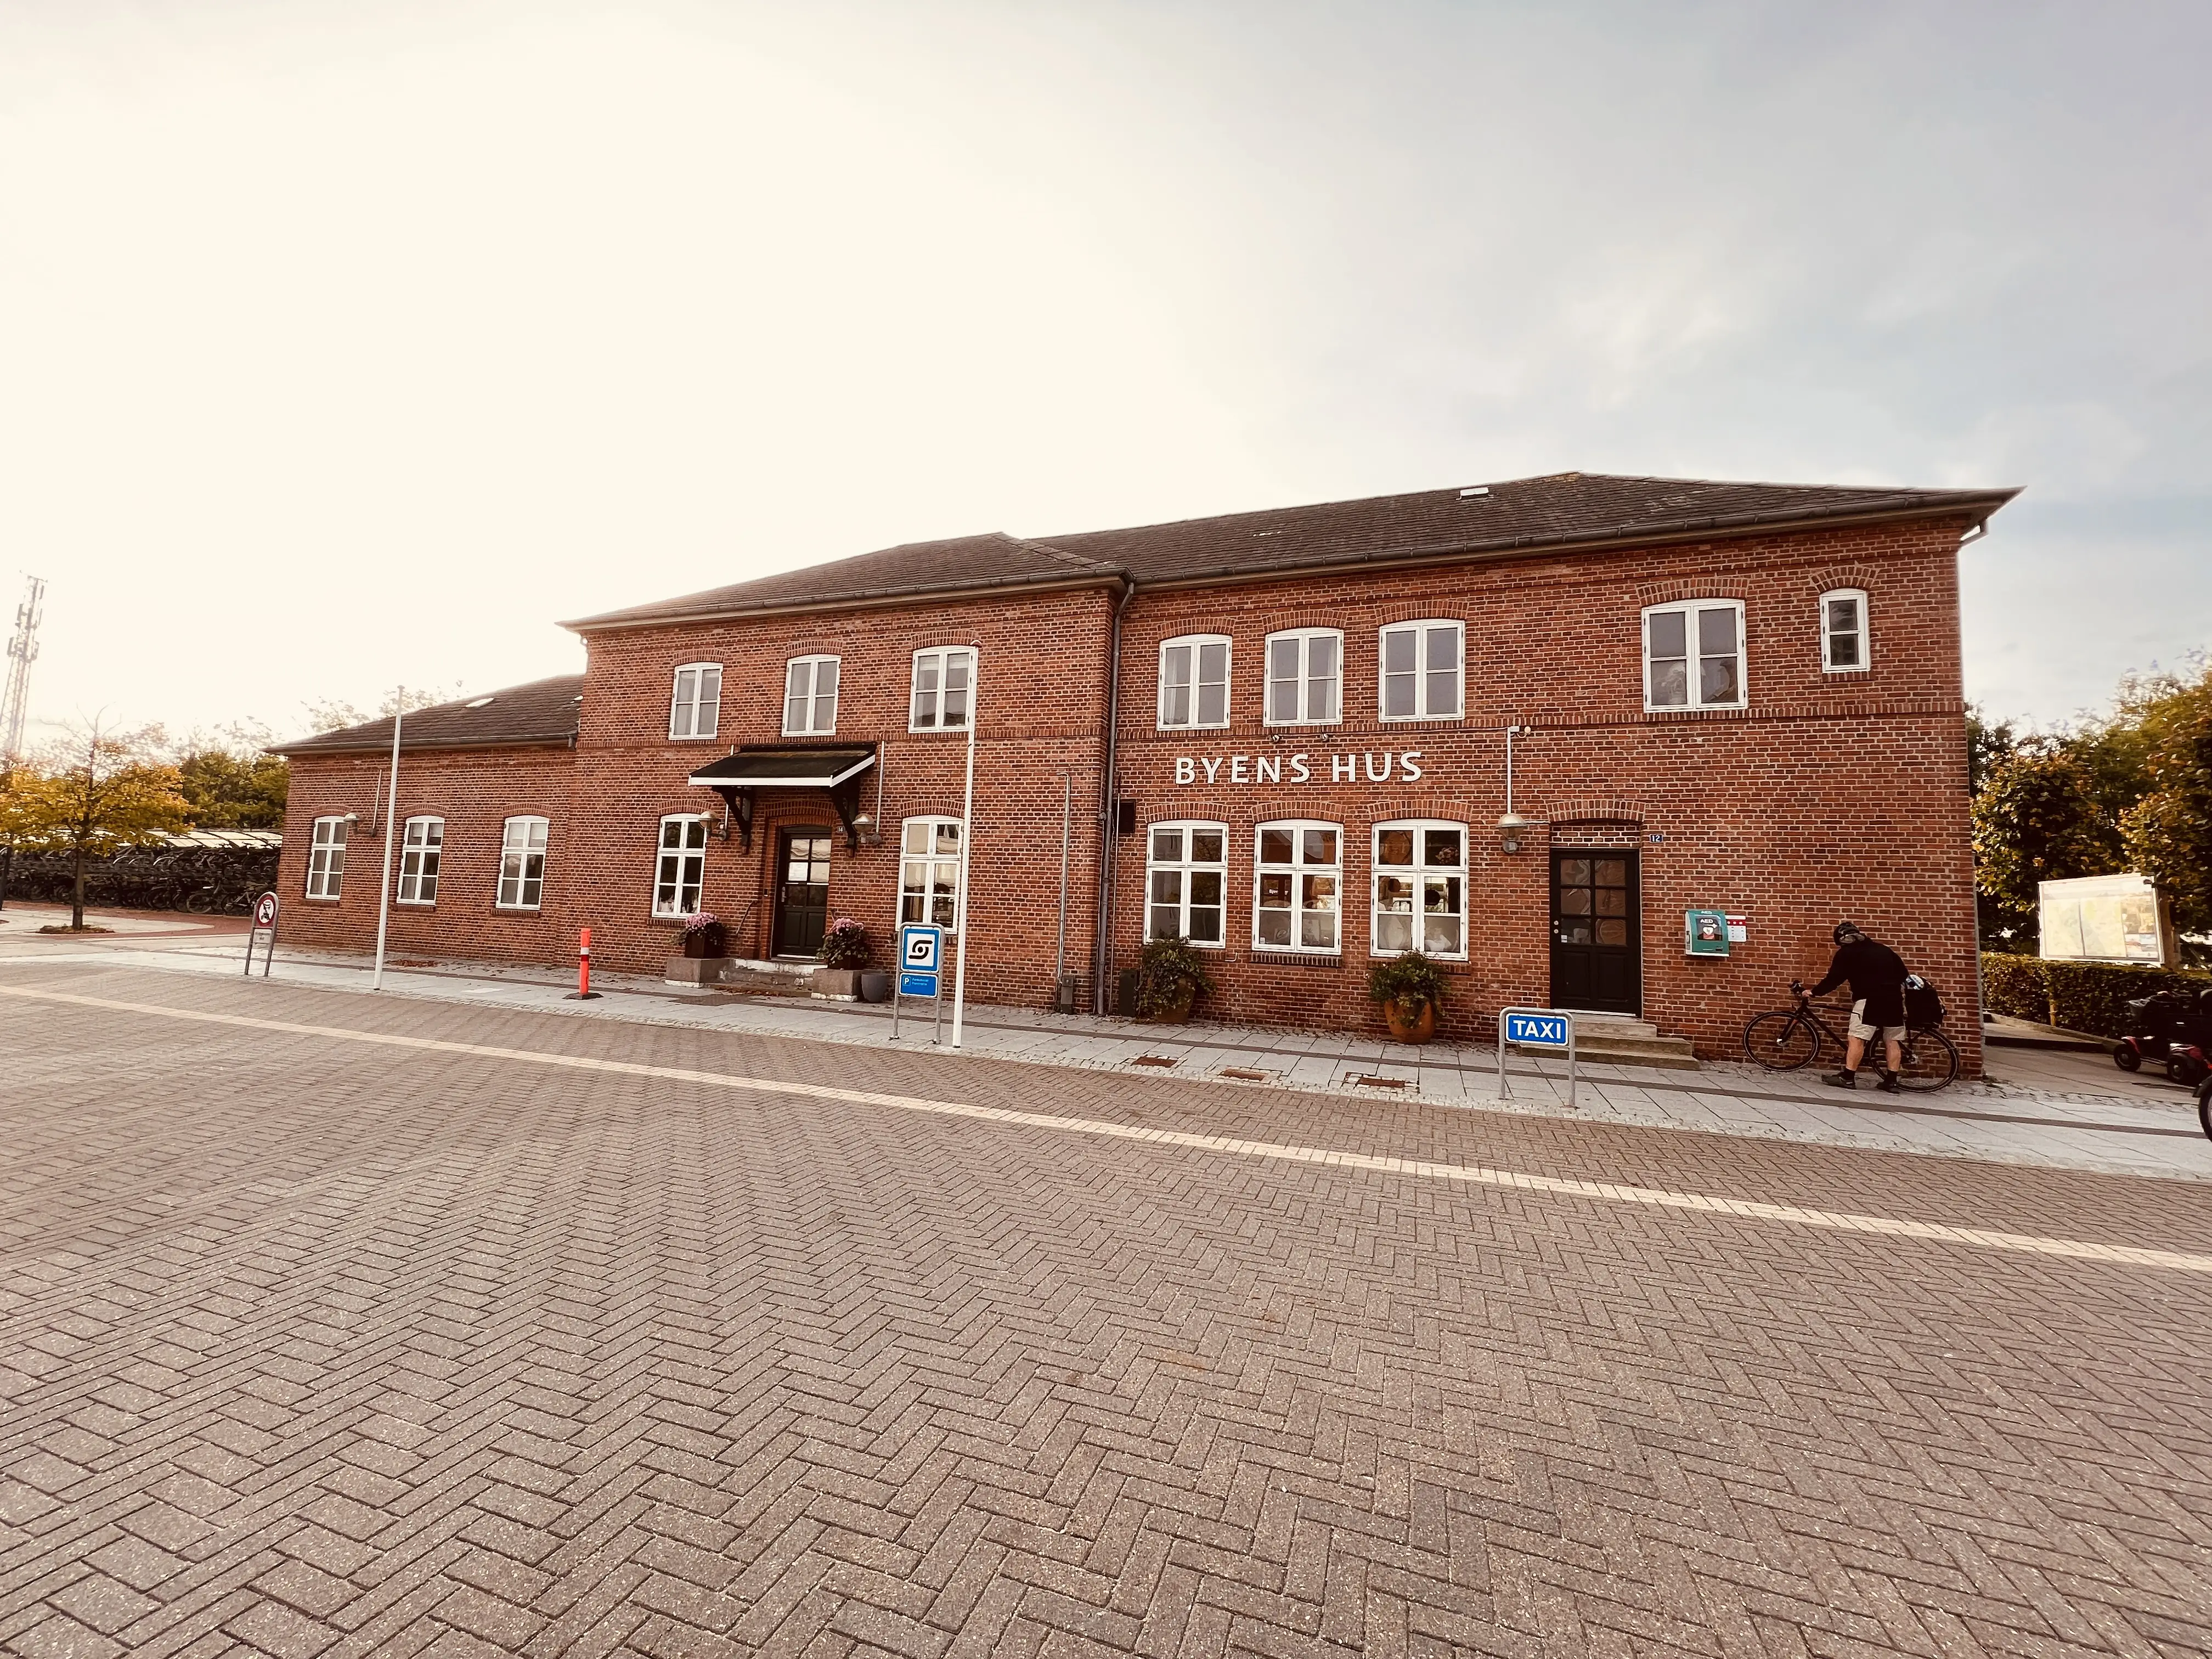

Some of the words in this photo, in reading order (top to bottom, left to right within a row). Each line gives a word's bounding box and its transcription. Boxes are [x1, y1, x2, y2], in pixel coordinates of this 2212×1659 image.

[1175, 753, 1311, 785] BYENS
[1331, 751, 1423, 782] HUS
[1513, 1020, 1561, 1039] TAXI
